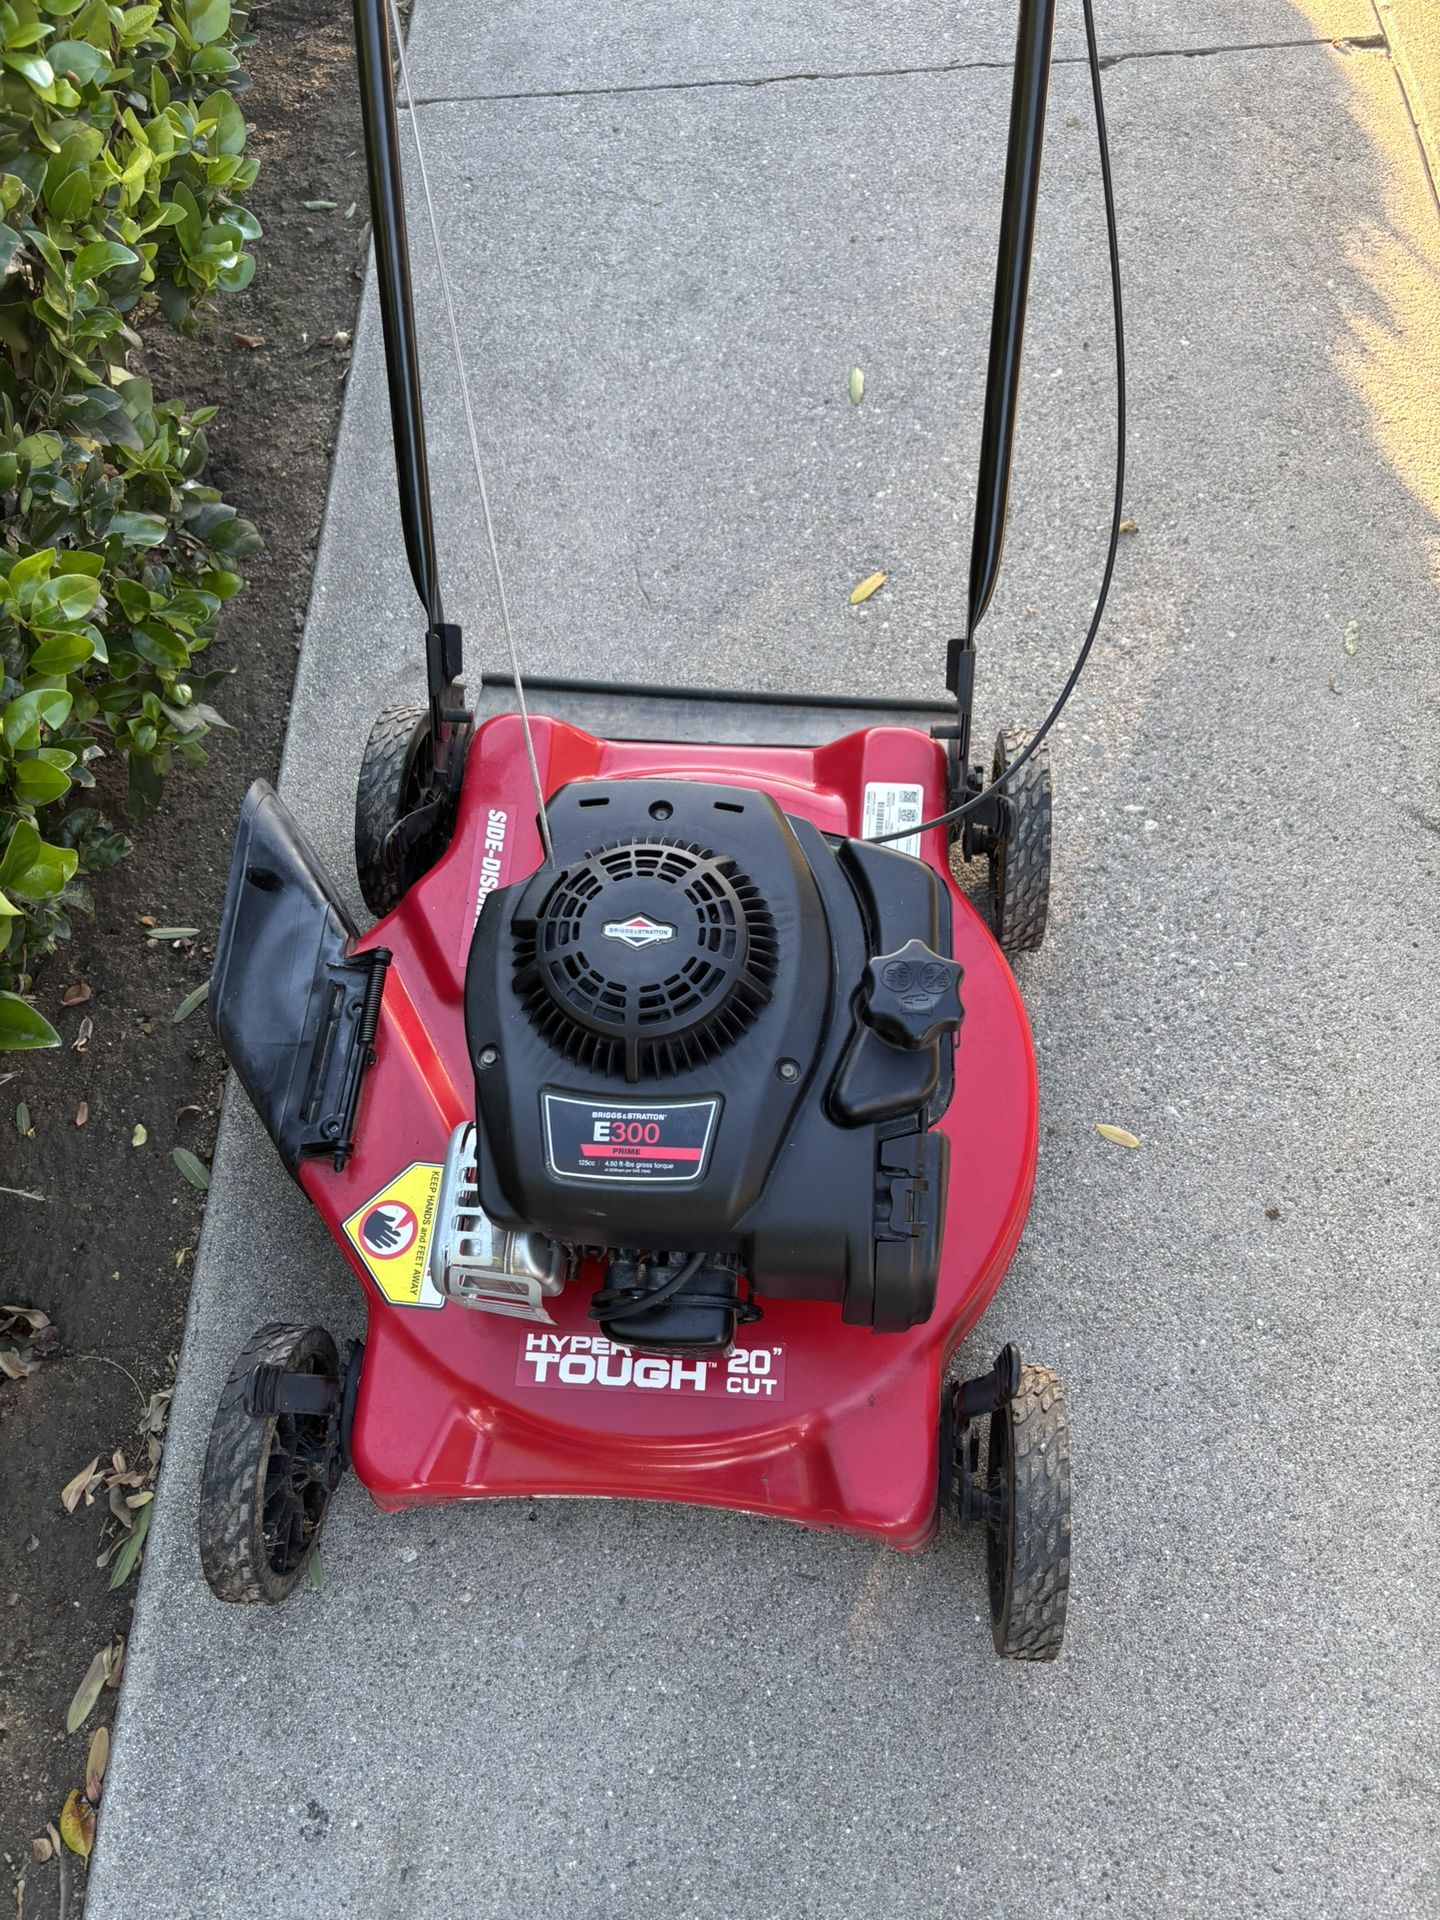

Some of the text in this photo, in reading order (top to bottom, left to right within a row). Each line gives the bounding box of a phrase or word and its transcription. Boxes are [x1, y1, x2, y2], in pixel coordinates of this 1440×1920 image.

[593, 1121, 661, 1144] E300
[612, 1147, 641, 1156] PRIME
[578, 1159, 596, 1167] 125cc
[604, 1160, 618, 1168] 4.50
[618, 1160, 635, 1169] ft-lbs
[635, 1162, 653, 1170] gross
[653, 1162, 674, 1171] torque
[409, 1170, 440, 1296] KEEP HANDS and FEET AWAY
[726, 1377, 777, 1395] CUT
